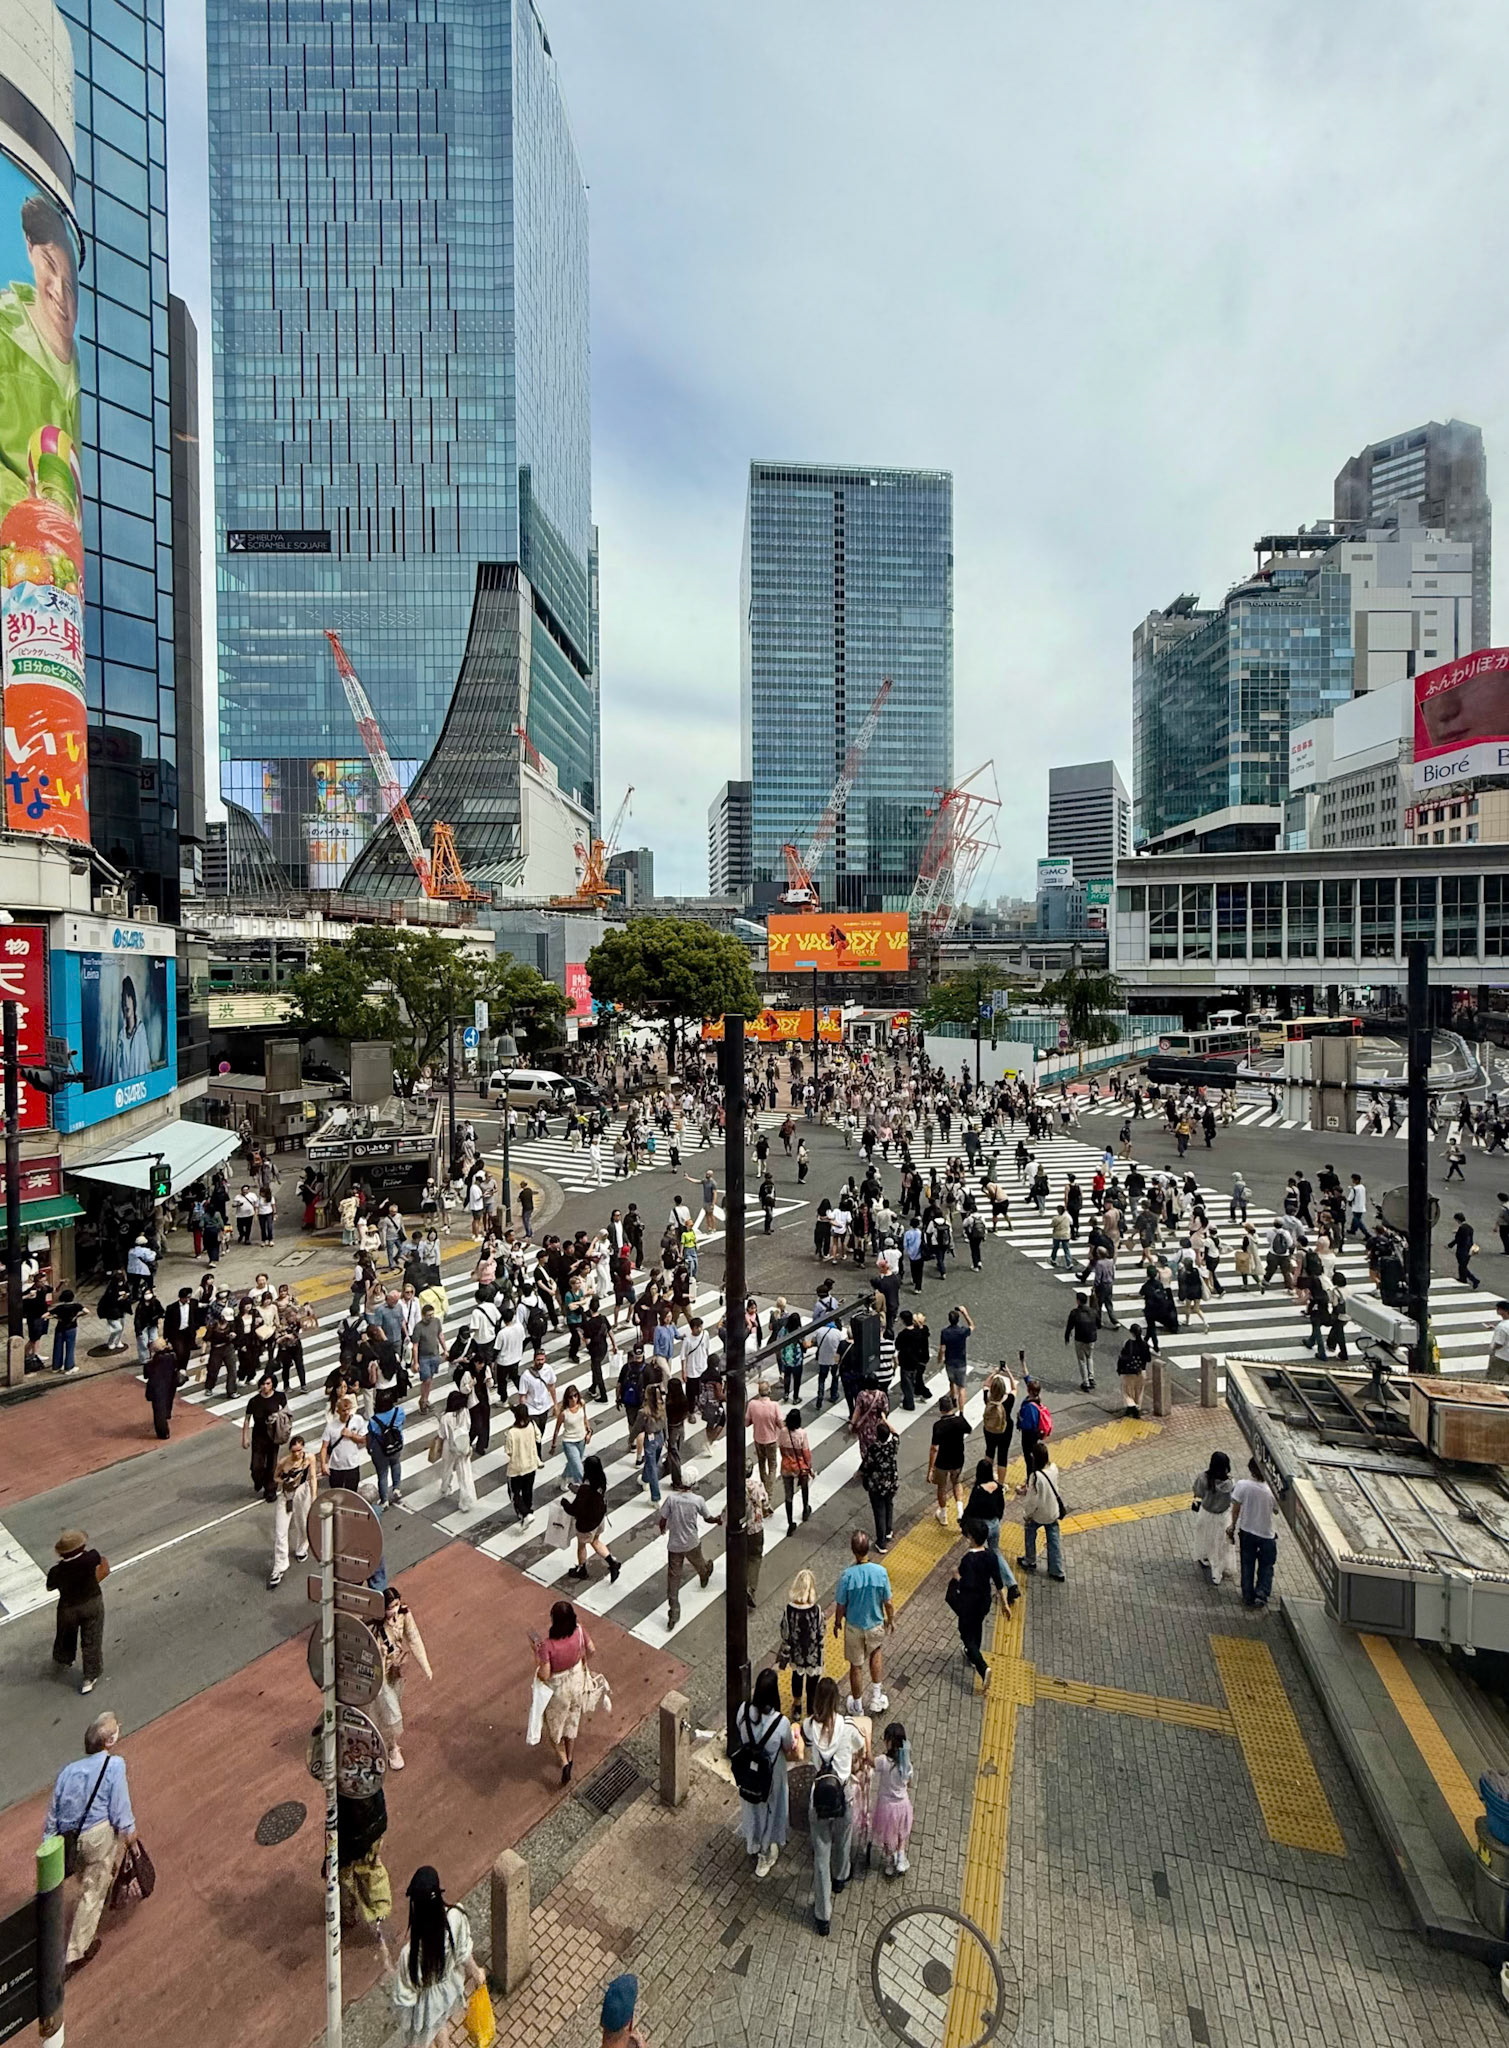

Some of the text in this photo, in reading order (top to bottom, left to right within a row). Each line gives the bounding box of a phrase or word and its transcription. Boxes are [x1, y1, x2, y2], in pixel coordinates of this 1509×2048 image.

[247, 533, 285, 542] SHIBUYA
[247, 541, 328, 550] SCRAMBLE SQUARE
[1424, 754, 1470, 783] Bioré
[1040, 867, 1067, 876] GMO
